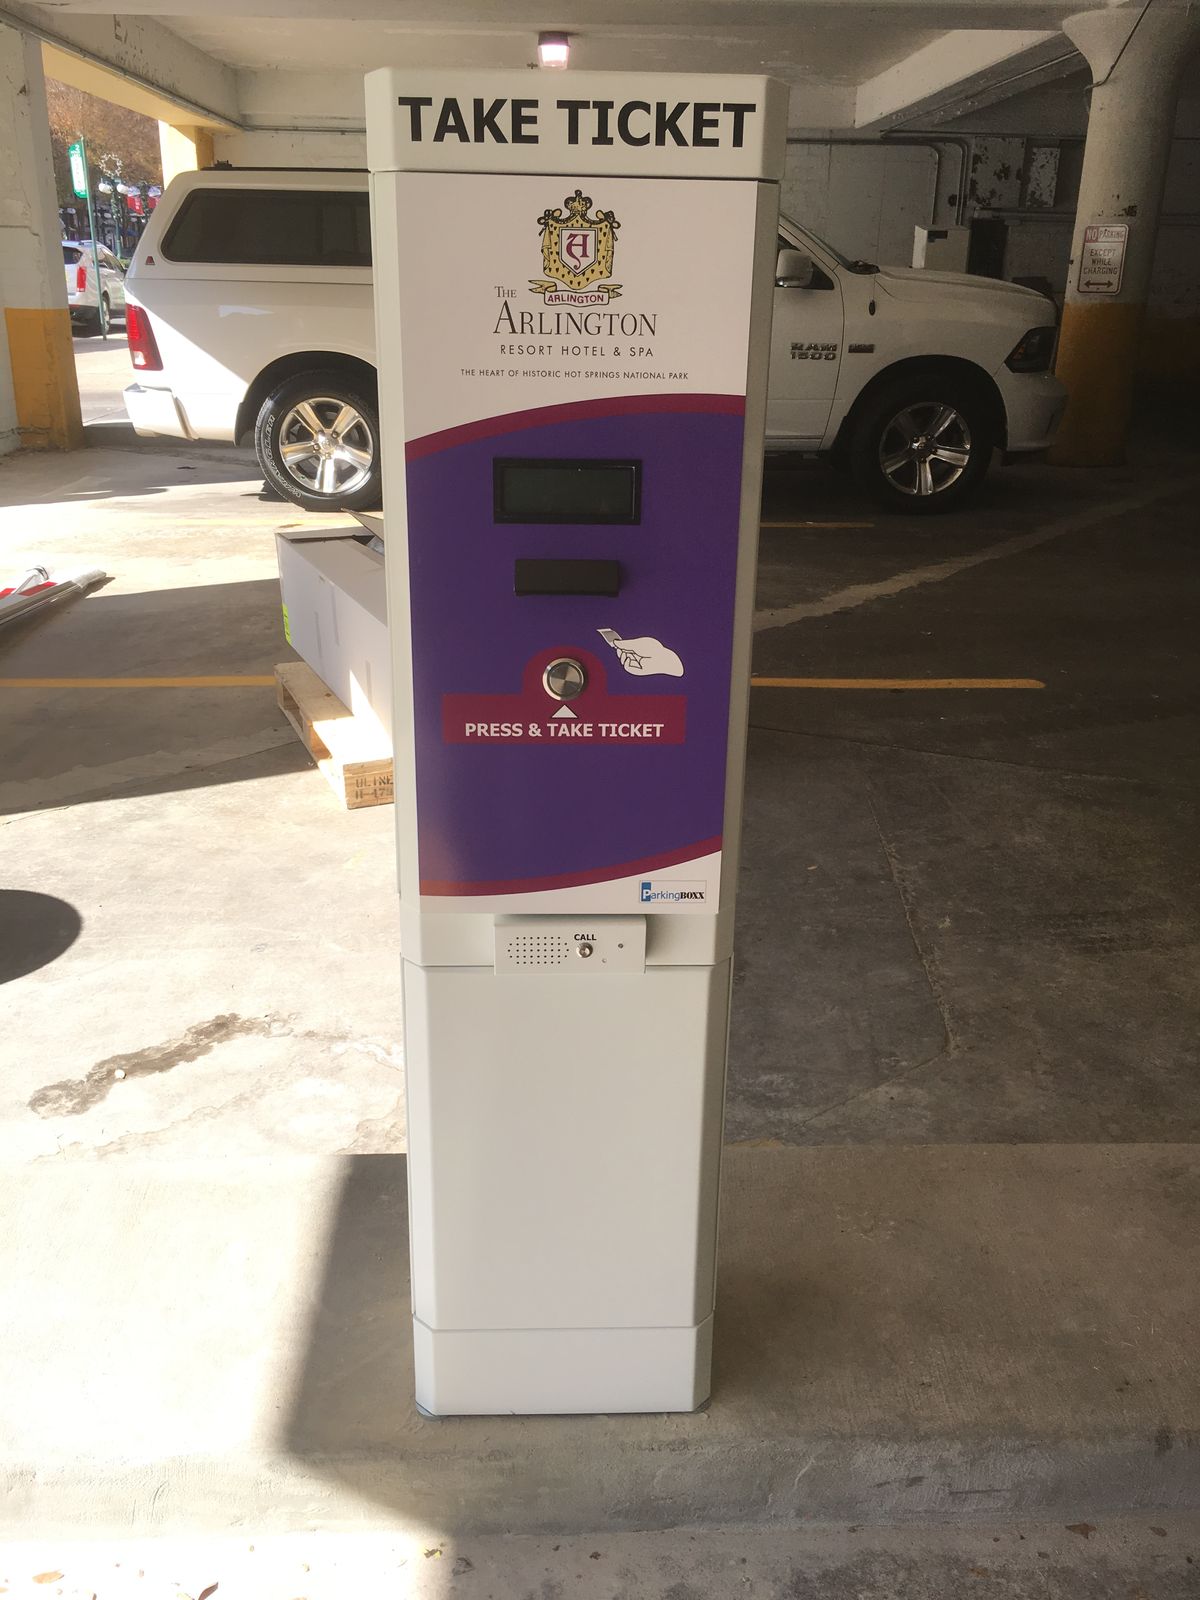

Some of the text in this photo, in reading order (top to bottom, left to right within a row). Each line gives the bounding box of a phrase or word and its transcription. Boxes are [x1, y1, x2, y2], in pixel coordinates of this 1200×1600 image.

[398, 96, 757, 148] TAKE TICKET
[1086, 228, 1098, 240] NO
[1090, 248, 1116, 257] EXCEPT
[1091, 258, 1112, 266] WHILE
[1083, 267, 1118, 275] CHARGING
[547, 294, 604, 304] ARLINGTON
[492, 300, 659, 337] ARLINGTON
[500, 344, 654, 357] RESORT HOTEL & SPA
[791, 343, 838, 351] RAM
[791, 351, 837, 361] 1500
[460, 368, 689, 380] THE HEART OF HISTORIC HOT SPRINGS NATIONAL PARK
[465, 723, 664, 738] PRESS & TAKE TICKET
[573, 933, 597, 941] CALL
